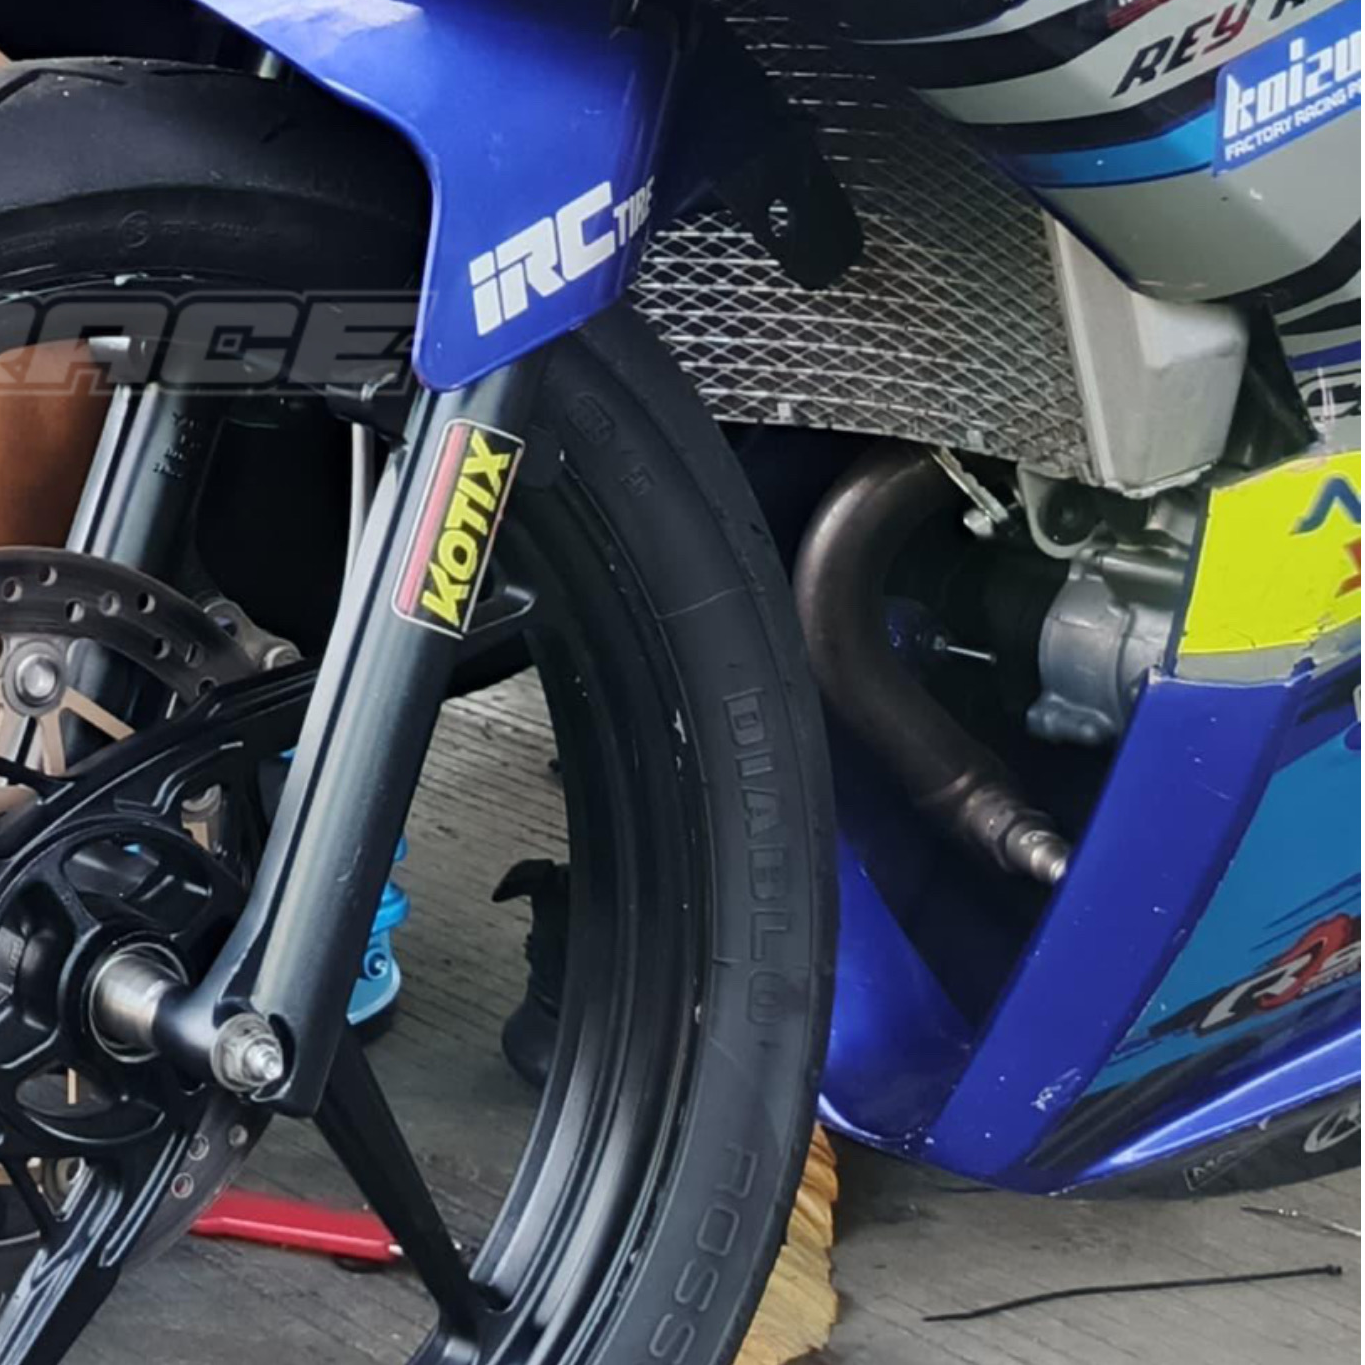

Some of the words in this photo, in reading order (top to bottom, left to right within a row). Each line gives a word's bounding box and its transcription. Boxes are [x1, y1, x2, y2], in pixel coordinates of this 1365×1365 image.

[1225, 115, 1292, 162] FACTORY
[1294, 87, 1347, 127] RACING
[421, 429, 511, 627] KOTIX
[721, 686, 790, 1027] DIABLO
